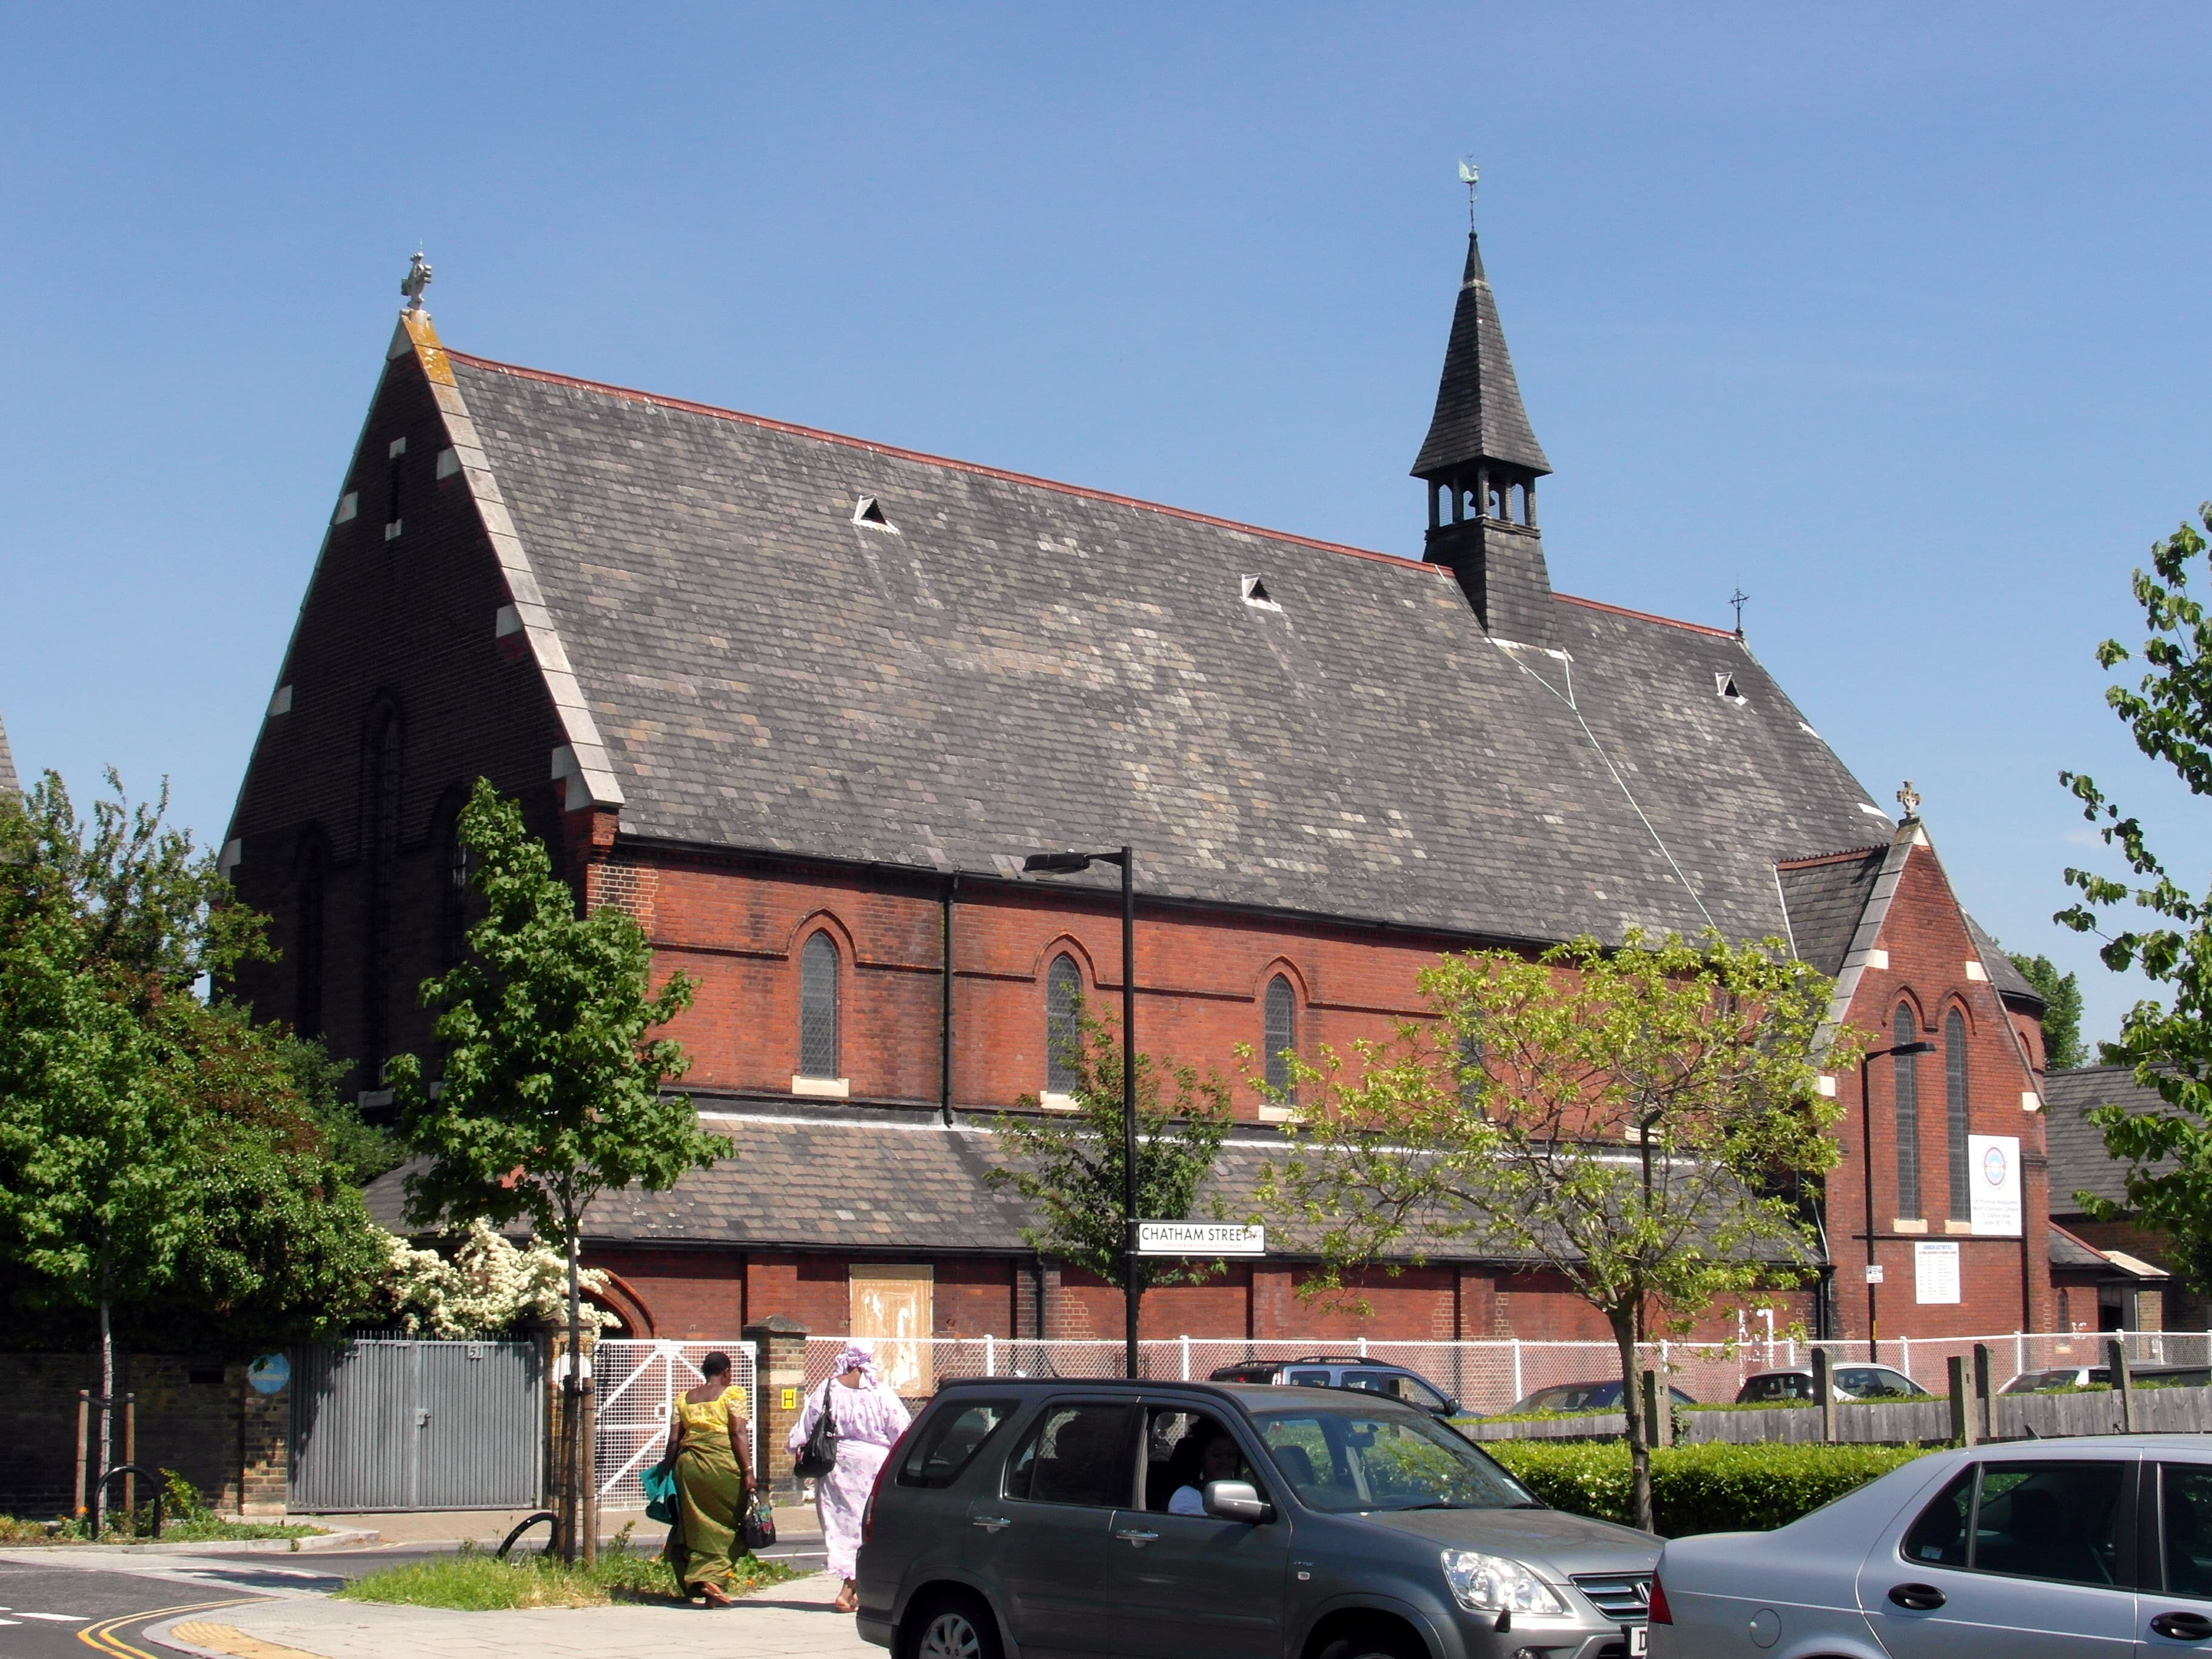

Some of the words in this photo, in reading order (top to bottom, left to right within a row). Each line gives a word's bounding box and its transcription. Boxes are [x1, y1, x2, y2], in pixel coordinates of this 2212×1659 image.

[1142, 1227, 1204, 1241] CHATHAM
[469, 1346, 481, 1357] 51
[783, 1392, 794, 1407] H
